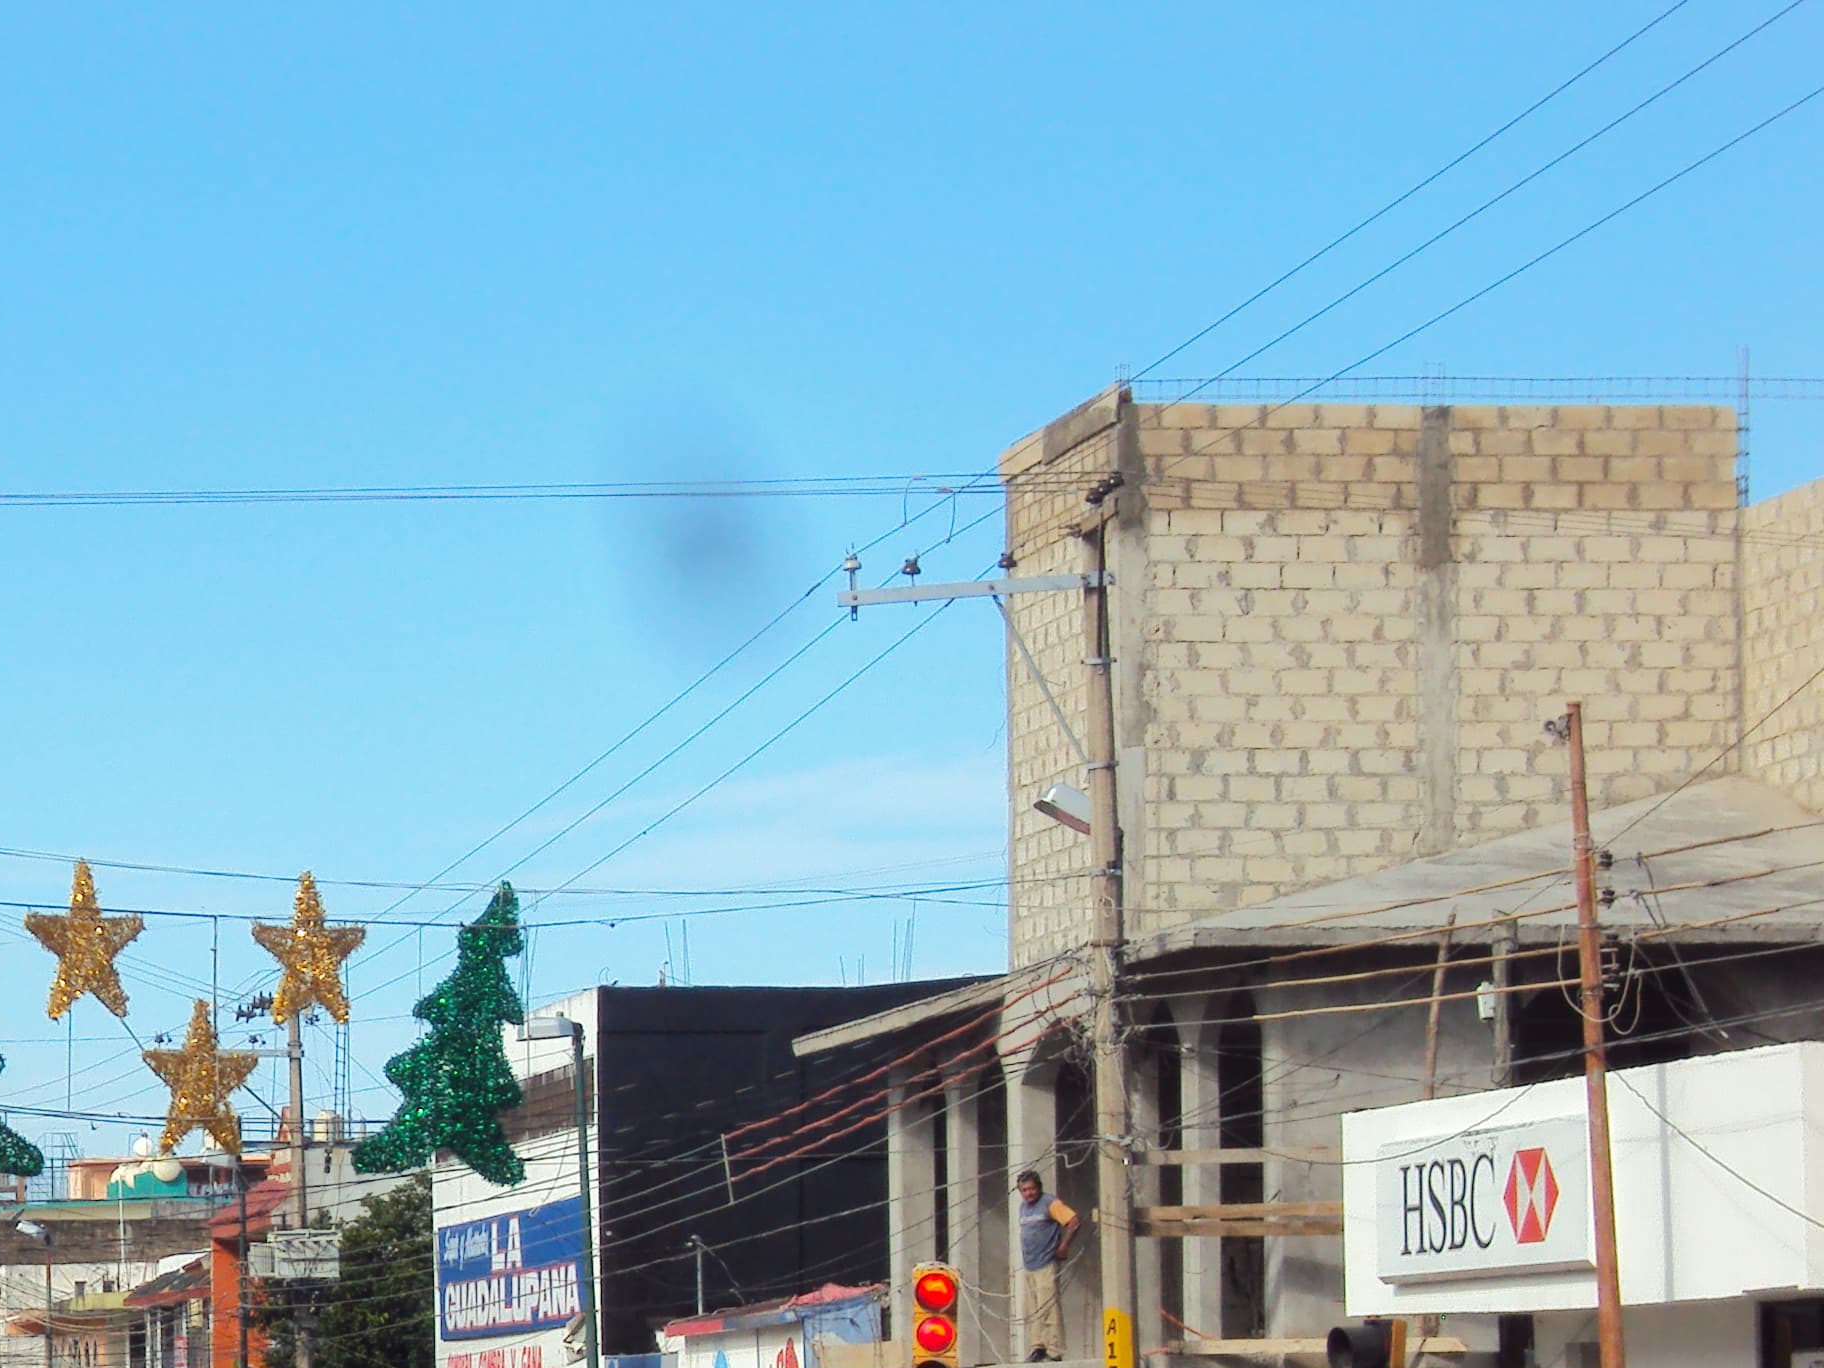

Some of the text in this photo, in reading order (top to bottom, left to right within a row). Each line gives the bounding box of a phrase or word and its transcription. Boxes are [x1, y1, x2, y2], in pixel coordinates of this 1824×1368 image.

[1399, 1154, 1497, 1256] HSBC
[491, 1215, 523, 1272] LA
[444, 1262, 581, 1331] GUADALUPANA
